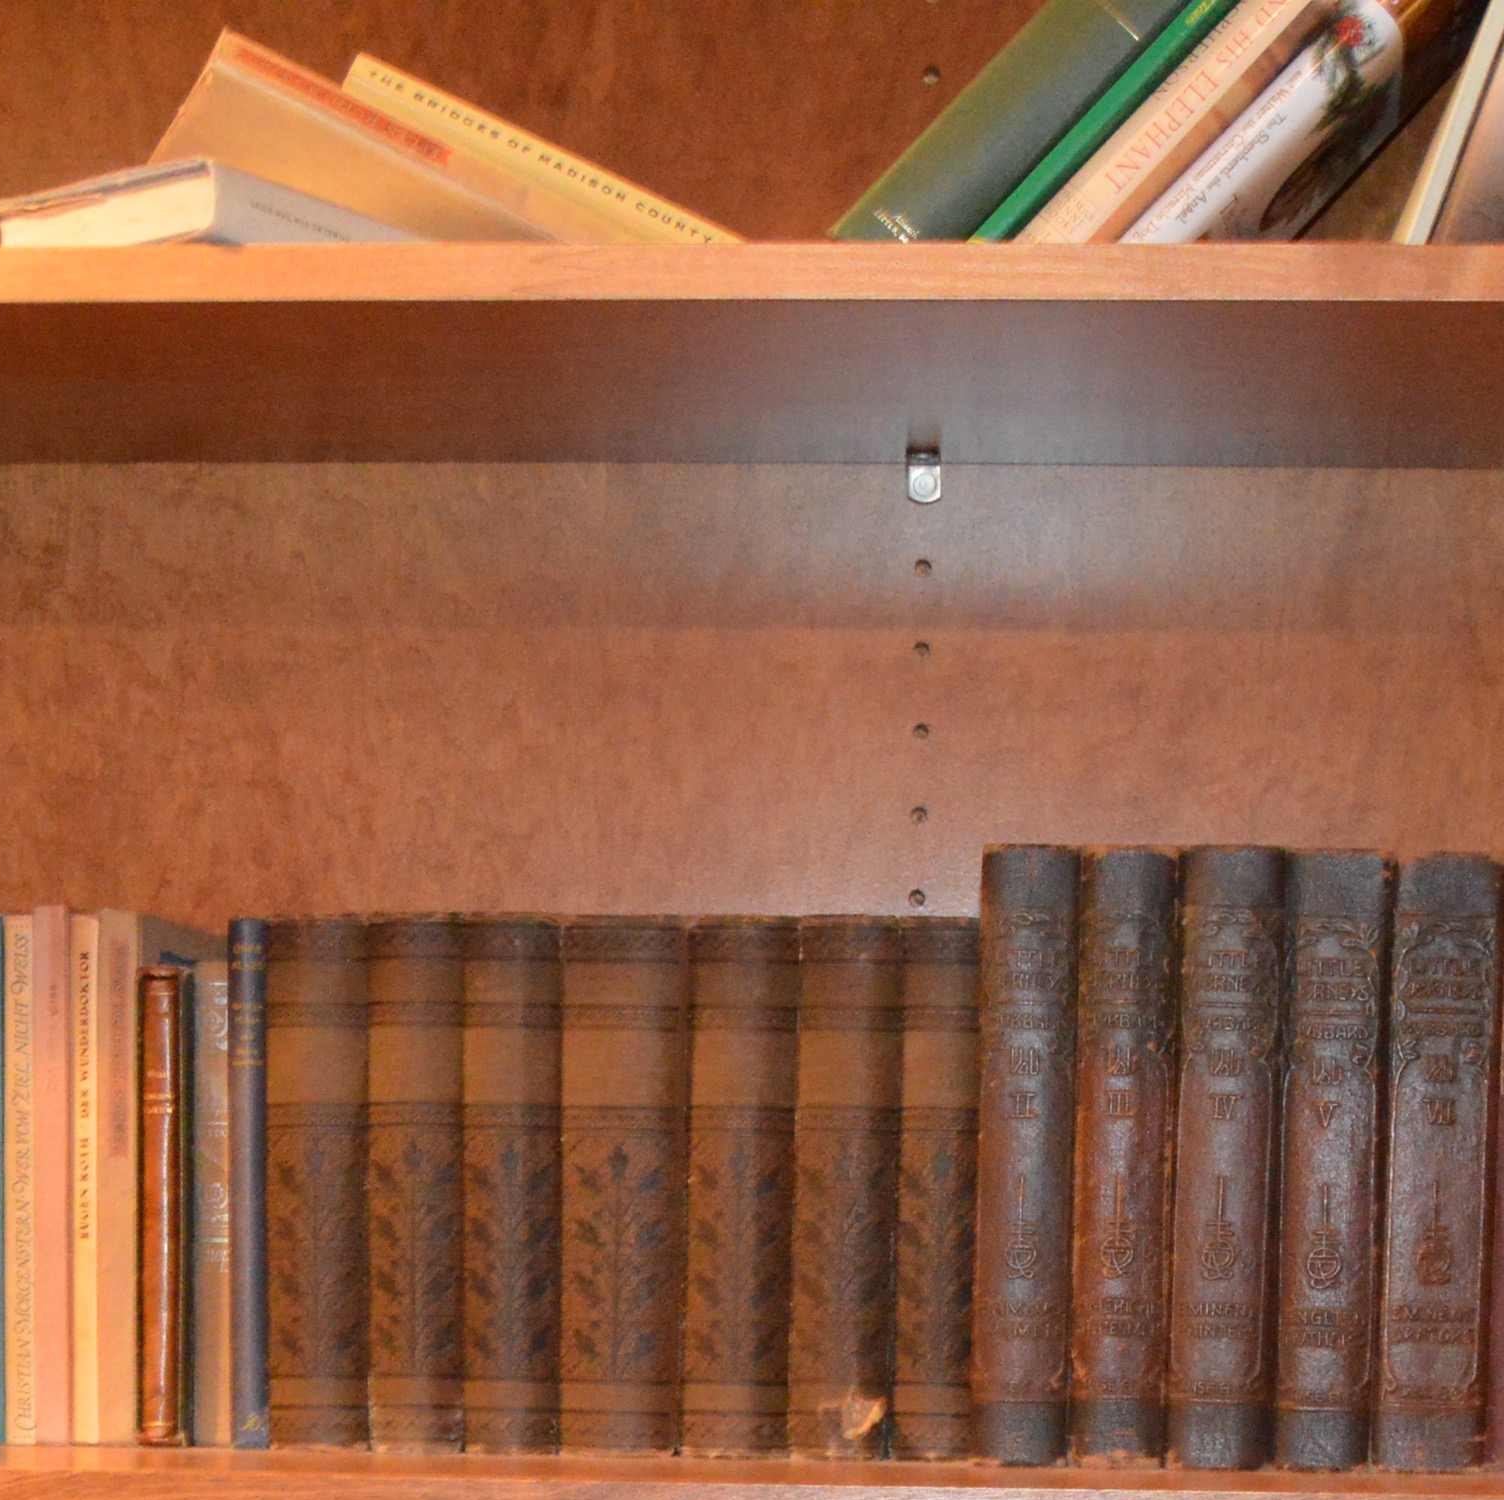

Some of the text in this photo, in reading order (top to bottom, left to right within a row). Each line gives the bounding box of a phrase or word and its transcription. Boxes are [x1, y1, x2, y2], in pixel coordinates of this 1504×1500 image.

[368, 70, 713, 245] THE BRIDGES OF MADISON COUNTY
[1105, 31, 1254, 195] HIS ELEPHANT
